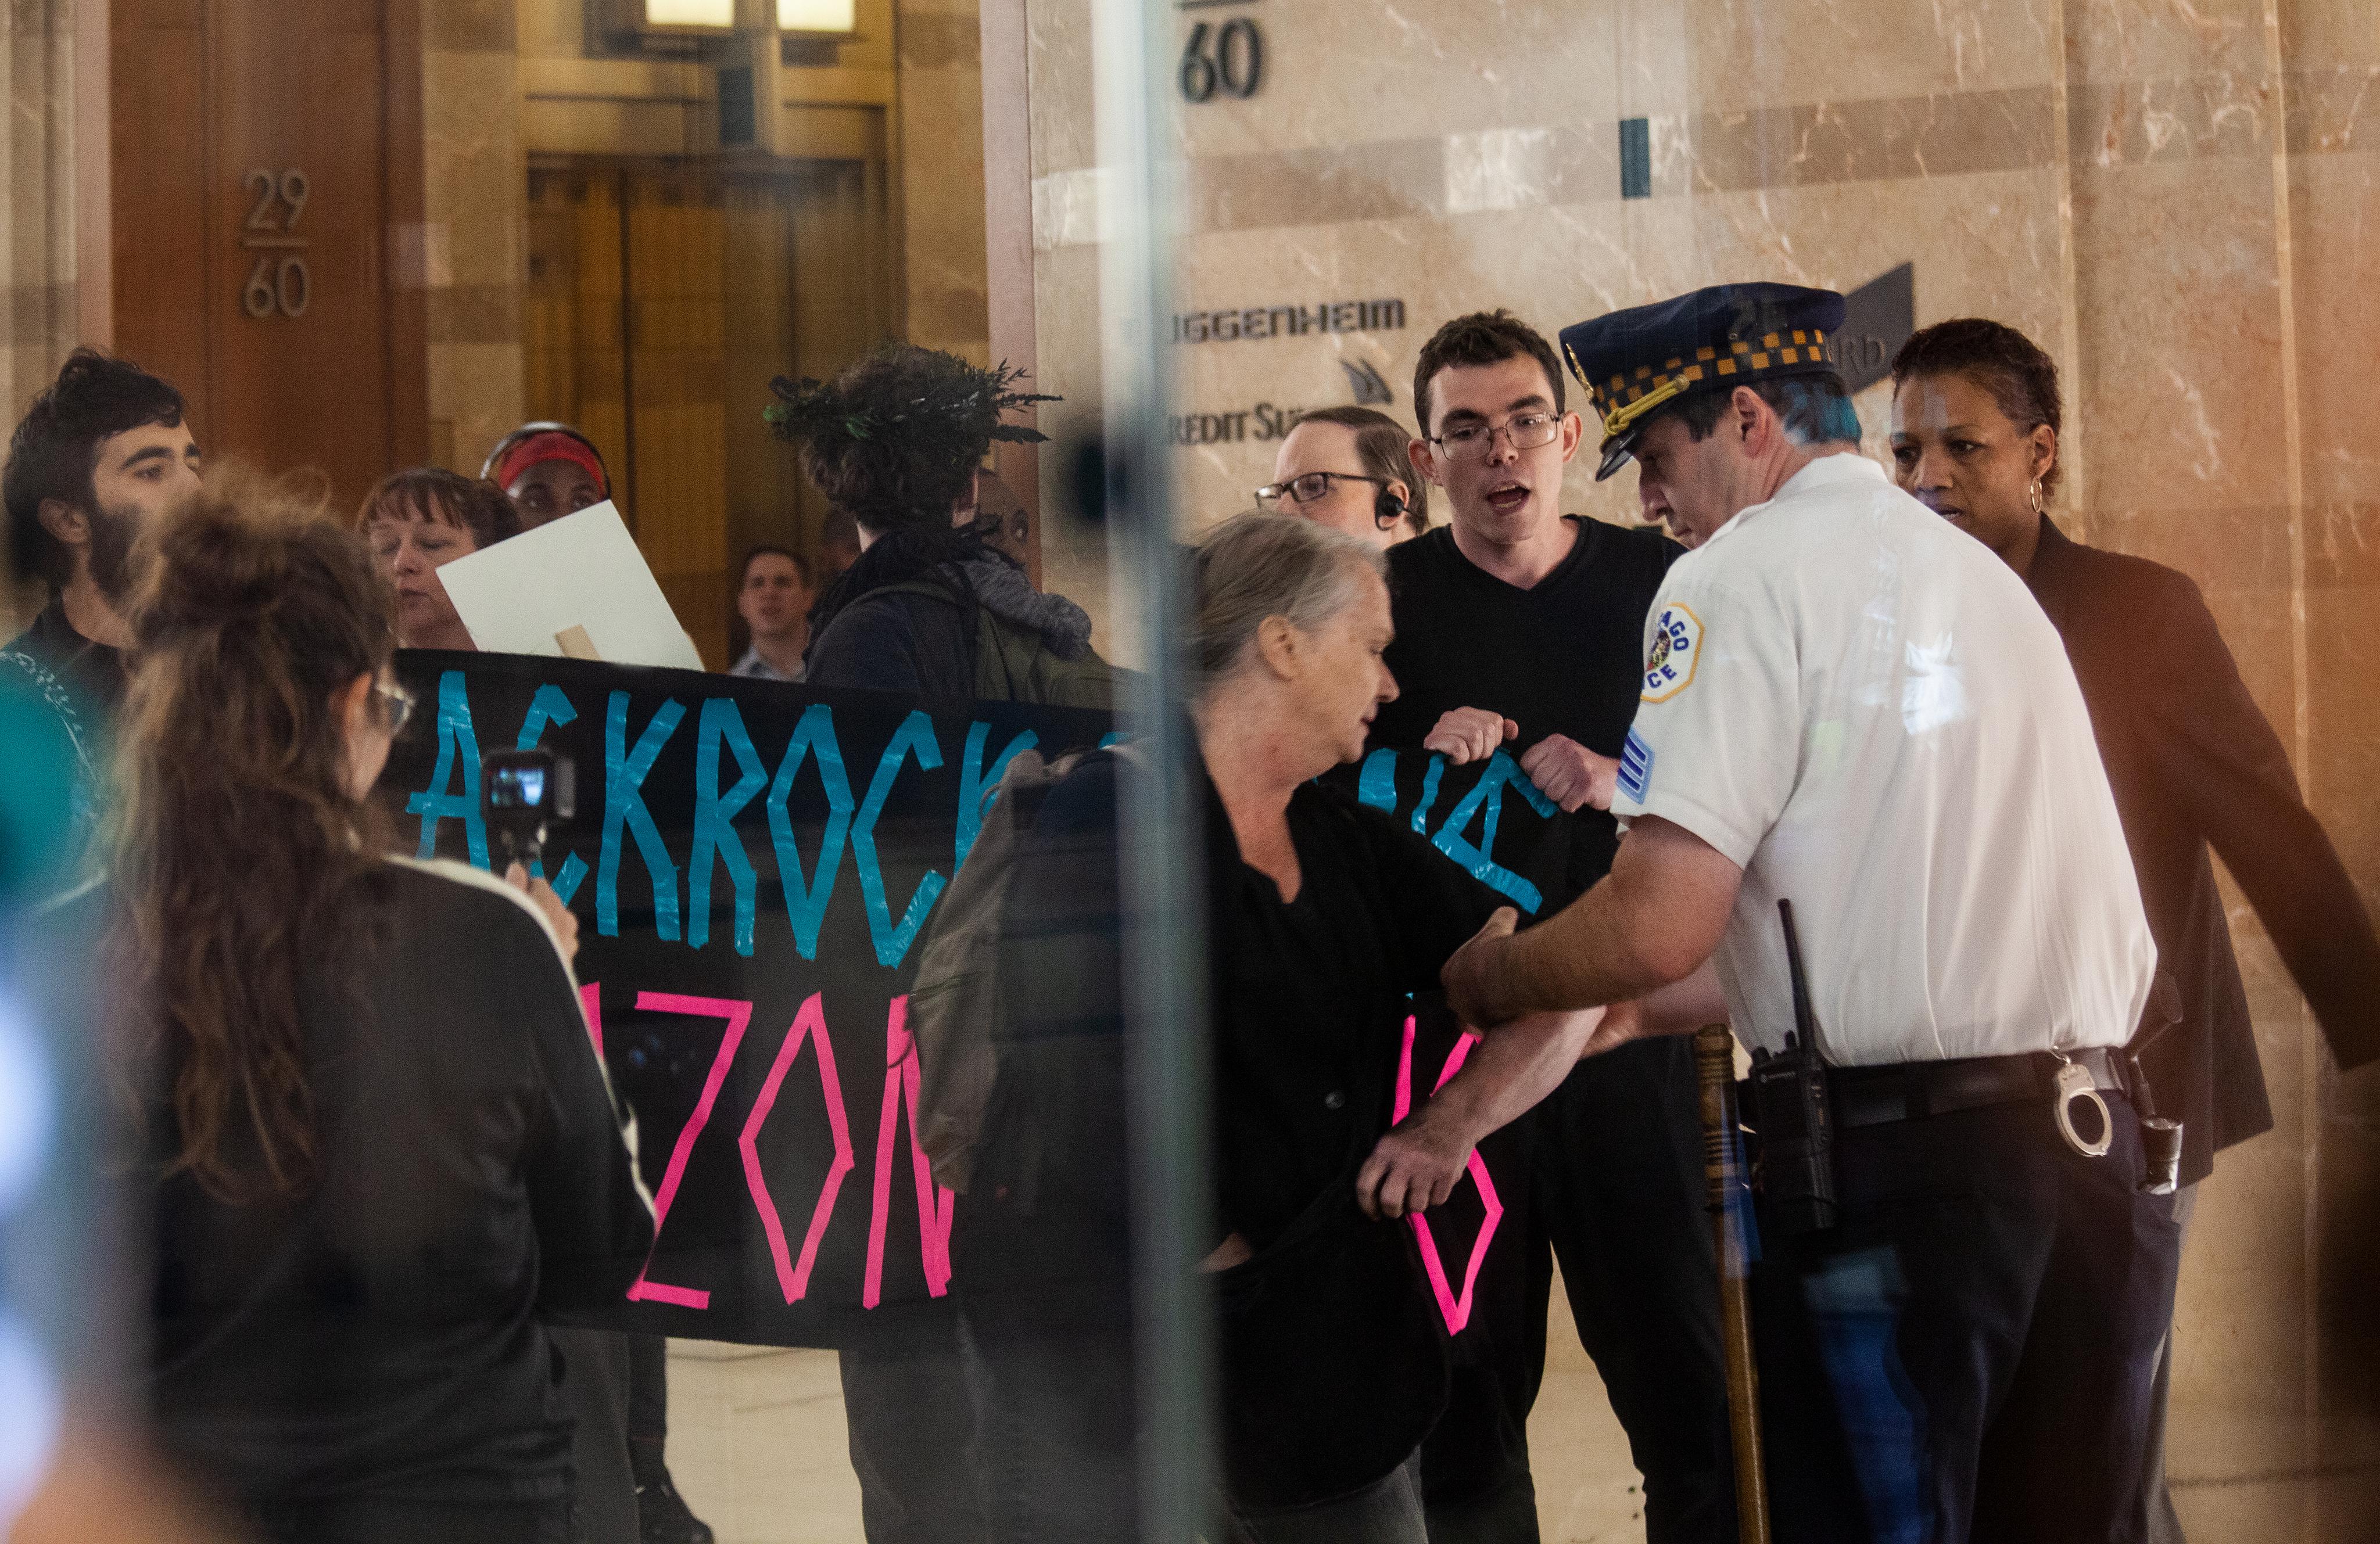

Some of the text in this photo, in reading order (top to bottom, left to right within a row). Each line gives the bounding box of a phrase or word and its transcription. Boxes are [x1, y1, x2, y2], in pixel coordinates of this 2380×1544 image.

[1179, 17, 1262, 102] 60
[242, 167, 310, 230] 29
[242, 257, 310, 318] 60
[1172, 299, 1406, 343] GGENHEIM
[1169, 410, 1248, 445] REDIT
[574, 982, 954, 1310] ZON
